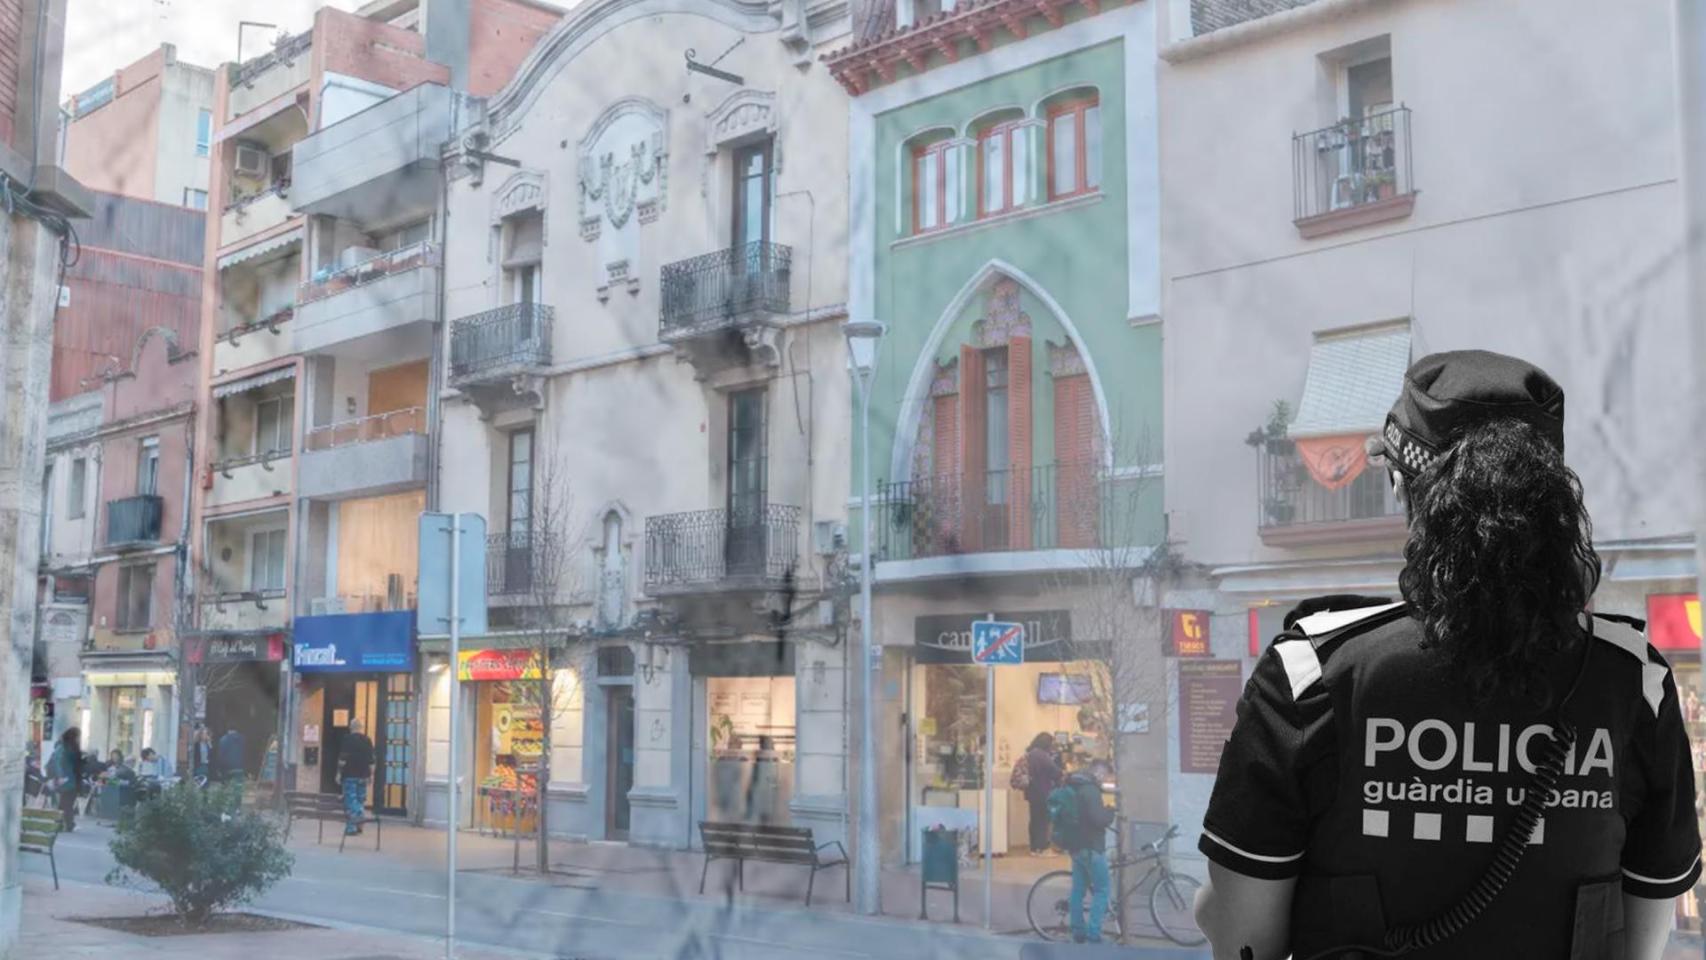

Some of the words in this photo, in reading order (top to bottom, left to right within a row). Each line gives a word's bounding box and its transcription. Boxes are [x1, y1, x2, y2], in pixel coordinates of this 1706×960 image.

[1364, 718, 1614, 777] POLICIA
[1363, 776, 1494, 804] guàrdia
[1506, 786, 1613, 809] uana
